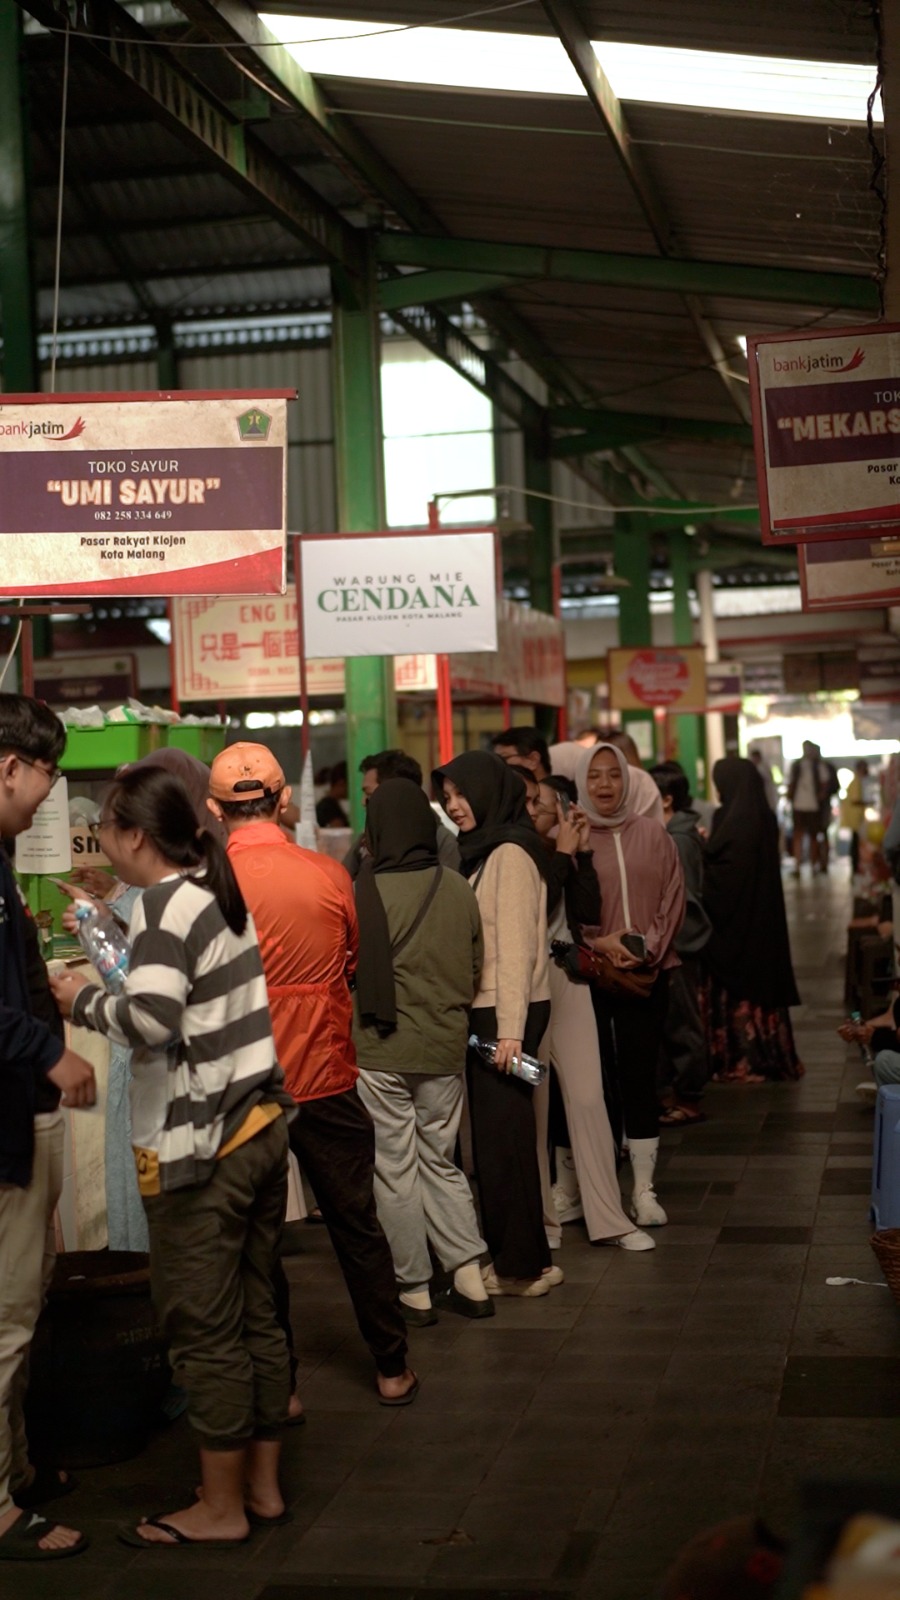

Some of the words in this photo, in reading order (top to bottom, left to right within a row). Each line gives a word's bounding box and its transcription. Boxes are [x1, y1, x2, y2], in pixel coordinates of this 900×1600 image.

[772, 354, 844, 373] bankjatim
[88, 461, 127, 474] TOKO
[131, 460, 179, 473] SAYUR
[867, 463, 898, 473] Pasar
[47, 479, 112, 506] “UMI
[119, 478, 221, 505] SAYUR”
[94, 511, 112, 521] 082
[115, 511, 132, 520] 258
[134, 511, 152, 520] 334
[155, 510, 172, 520] 649
[80, 537, 110, 546] Pasar
[113, 536, 150, 547] Rakyat
[153, 535, 186, 547] Klojen
[101, 551, 124, 560] Kota
[127, 549, 165, 560] Malang
[333, 574, 416, 586] WARUNG
[430, 572, 463, 583] MIE
[317, 584, 480, 613] CENDANA
